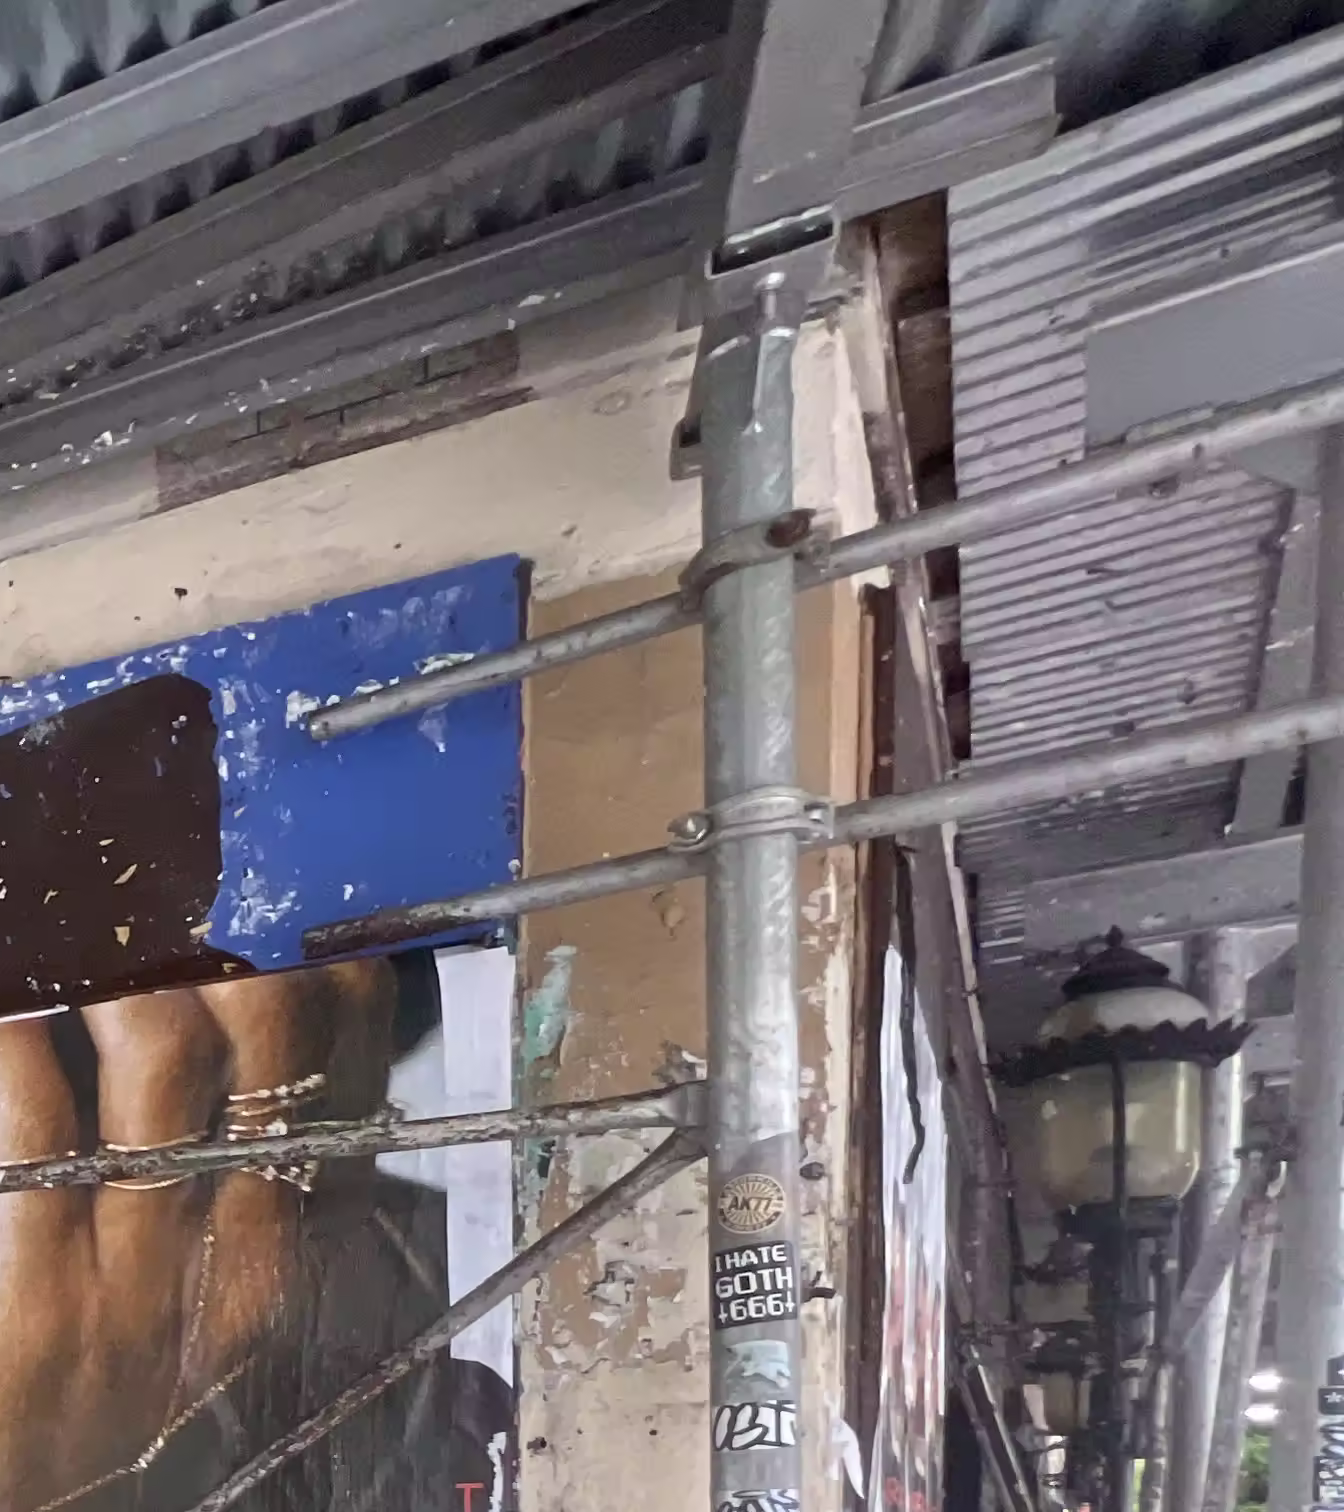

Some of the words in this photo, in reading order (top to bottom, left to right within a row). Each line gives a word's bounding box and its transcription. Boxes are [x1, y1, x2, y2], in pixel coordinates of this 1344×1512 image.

[715, 1255, 722, 1273] I
[725, 1244, 788, 1270] HATE
[715, 1266, 793, 1298] GOTH
